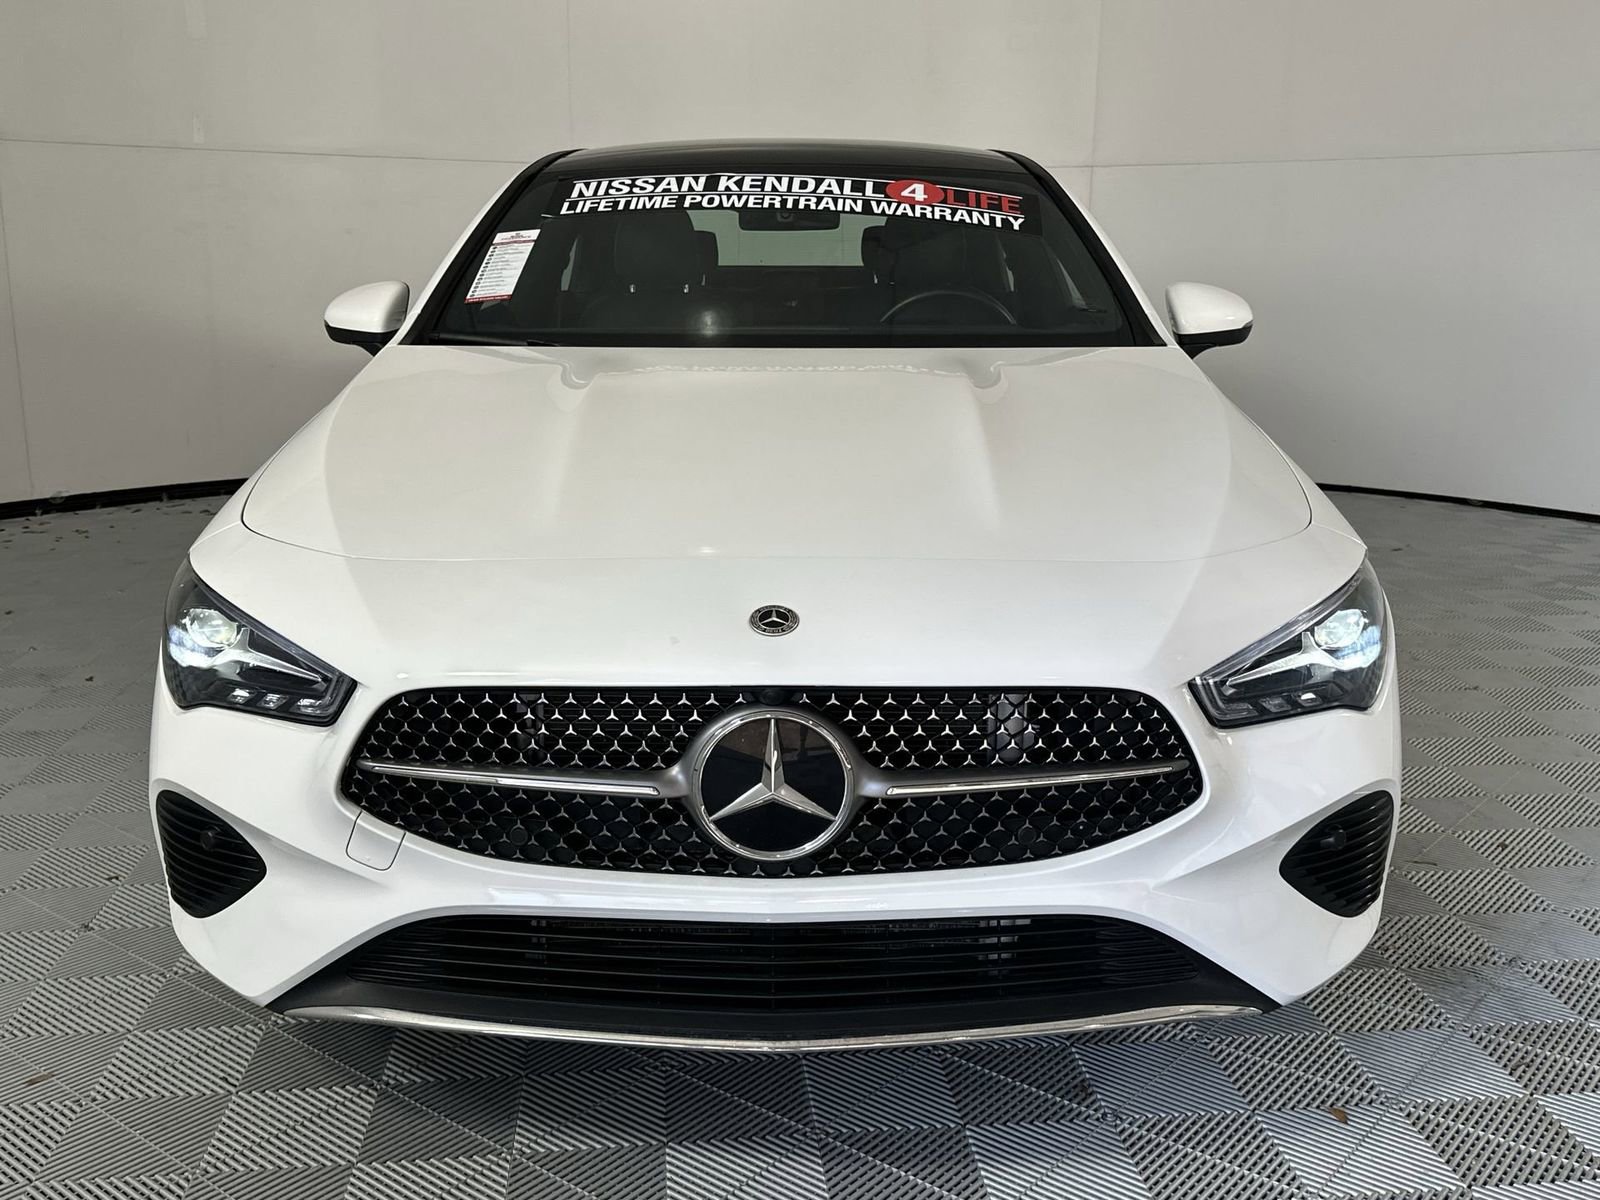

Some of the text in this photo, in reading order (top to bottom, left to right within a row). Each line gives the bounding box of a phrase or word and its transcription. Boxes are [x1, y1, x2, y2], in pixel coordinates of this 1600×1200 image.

[560, 194, 1025, 231] LIFETIME POWERTRAIN WARRANTY
[570, 175, 1022, 214] NISSAN KENDALL 4 LIFE
